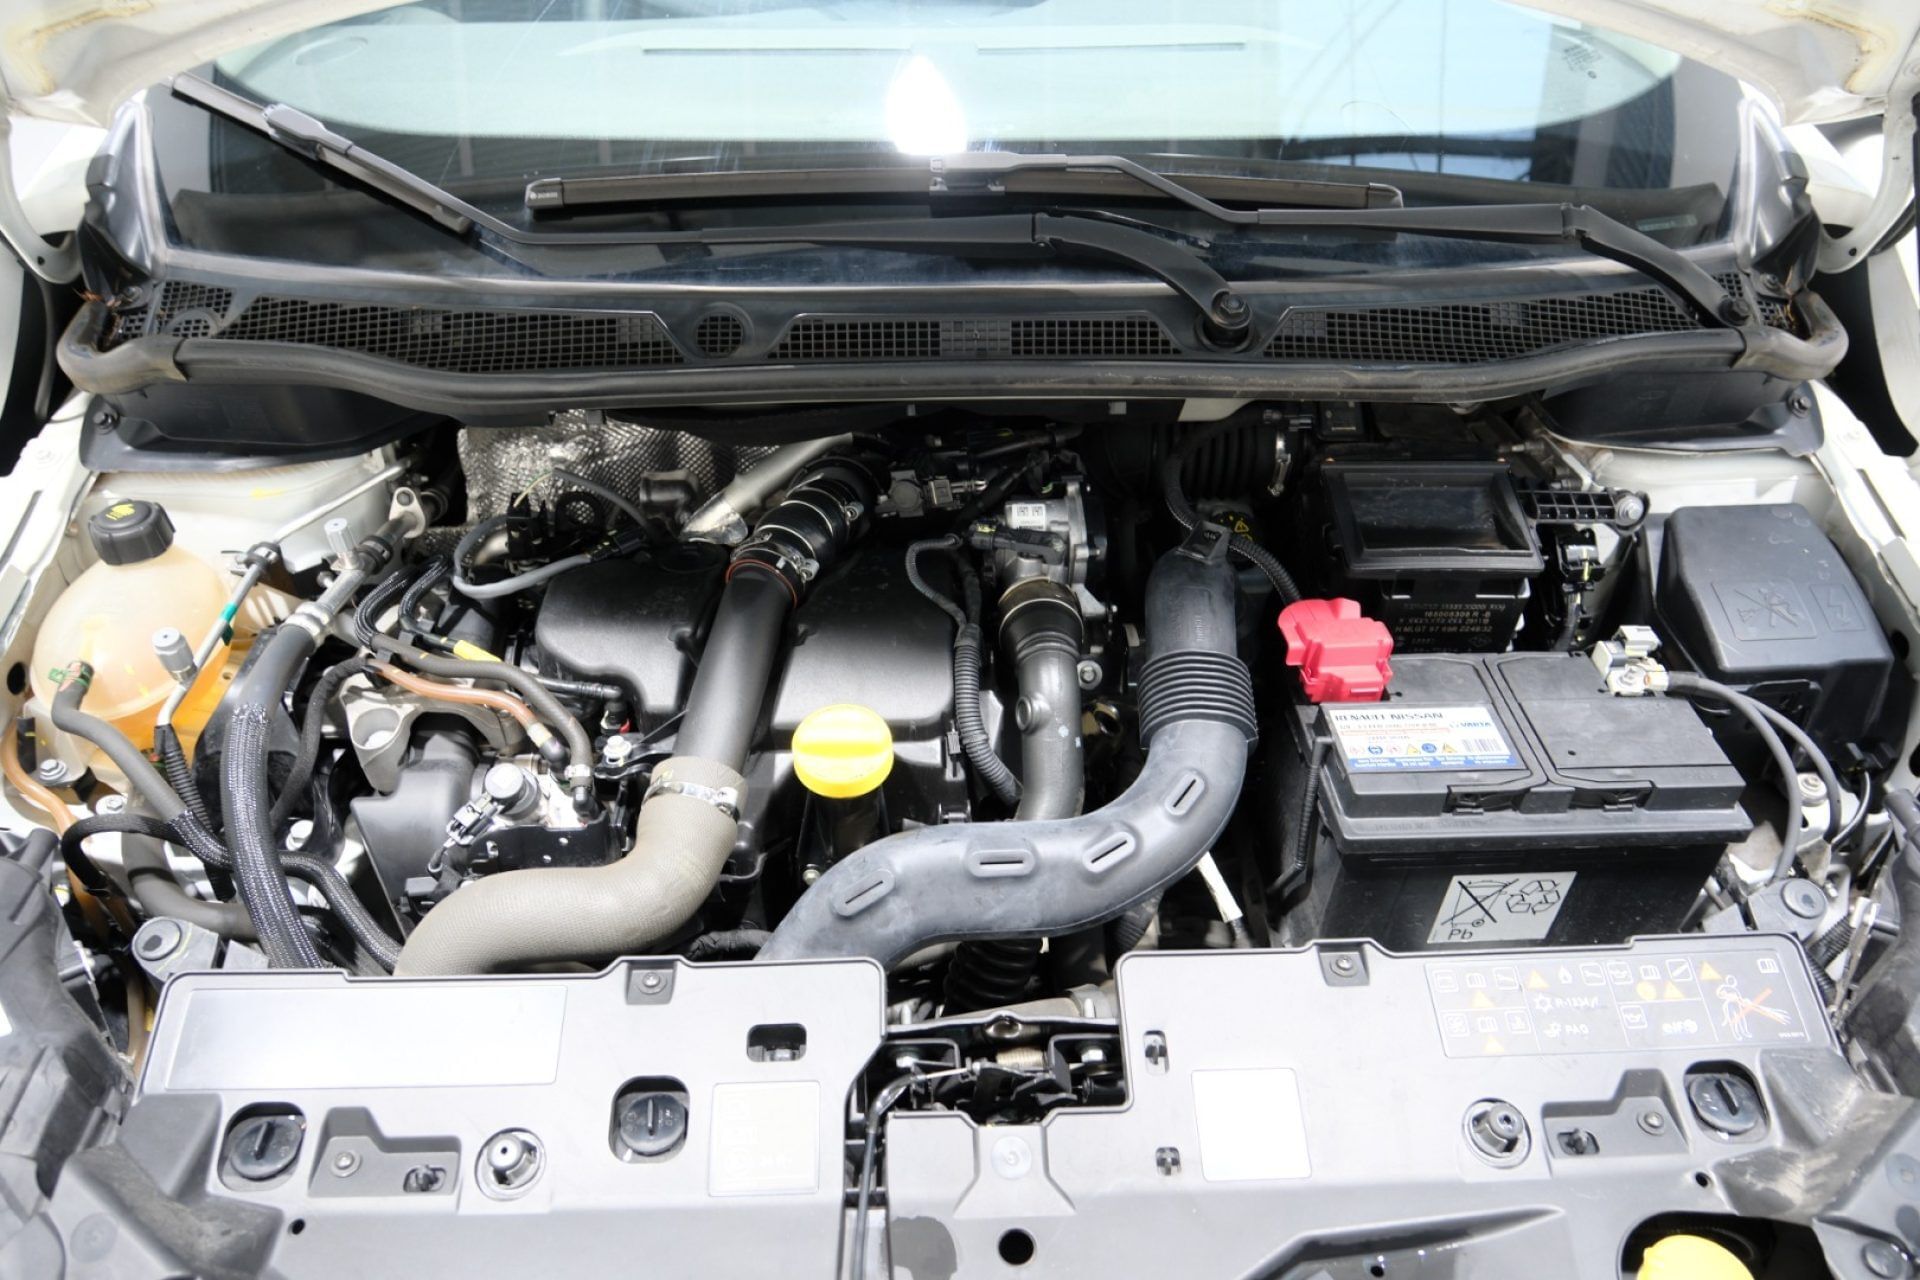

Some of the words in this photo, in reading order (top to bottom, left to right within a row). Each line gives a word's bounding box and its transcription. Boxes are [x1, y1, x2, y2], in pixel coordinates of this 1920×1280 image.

[1334, 713, 1386, 721] RENAULT
[1390, 711, 1444, 720] NISSAN
[1447, 928, 1473, 941] Pb
